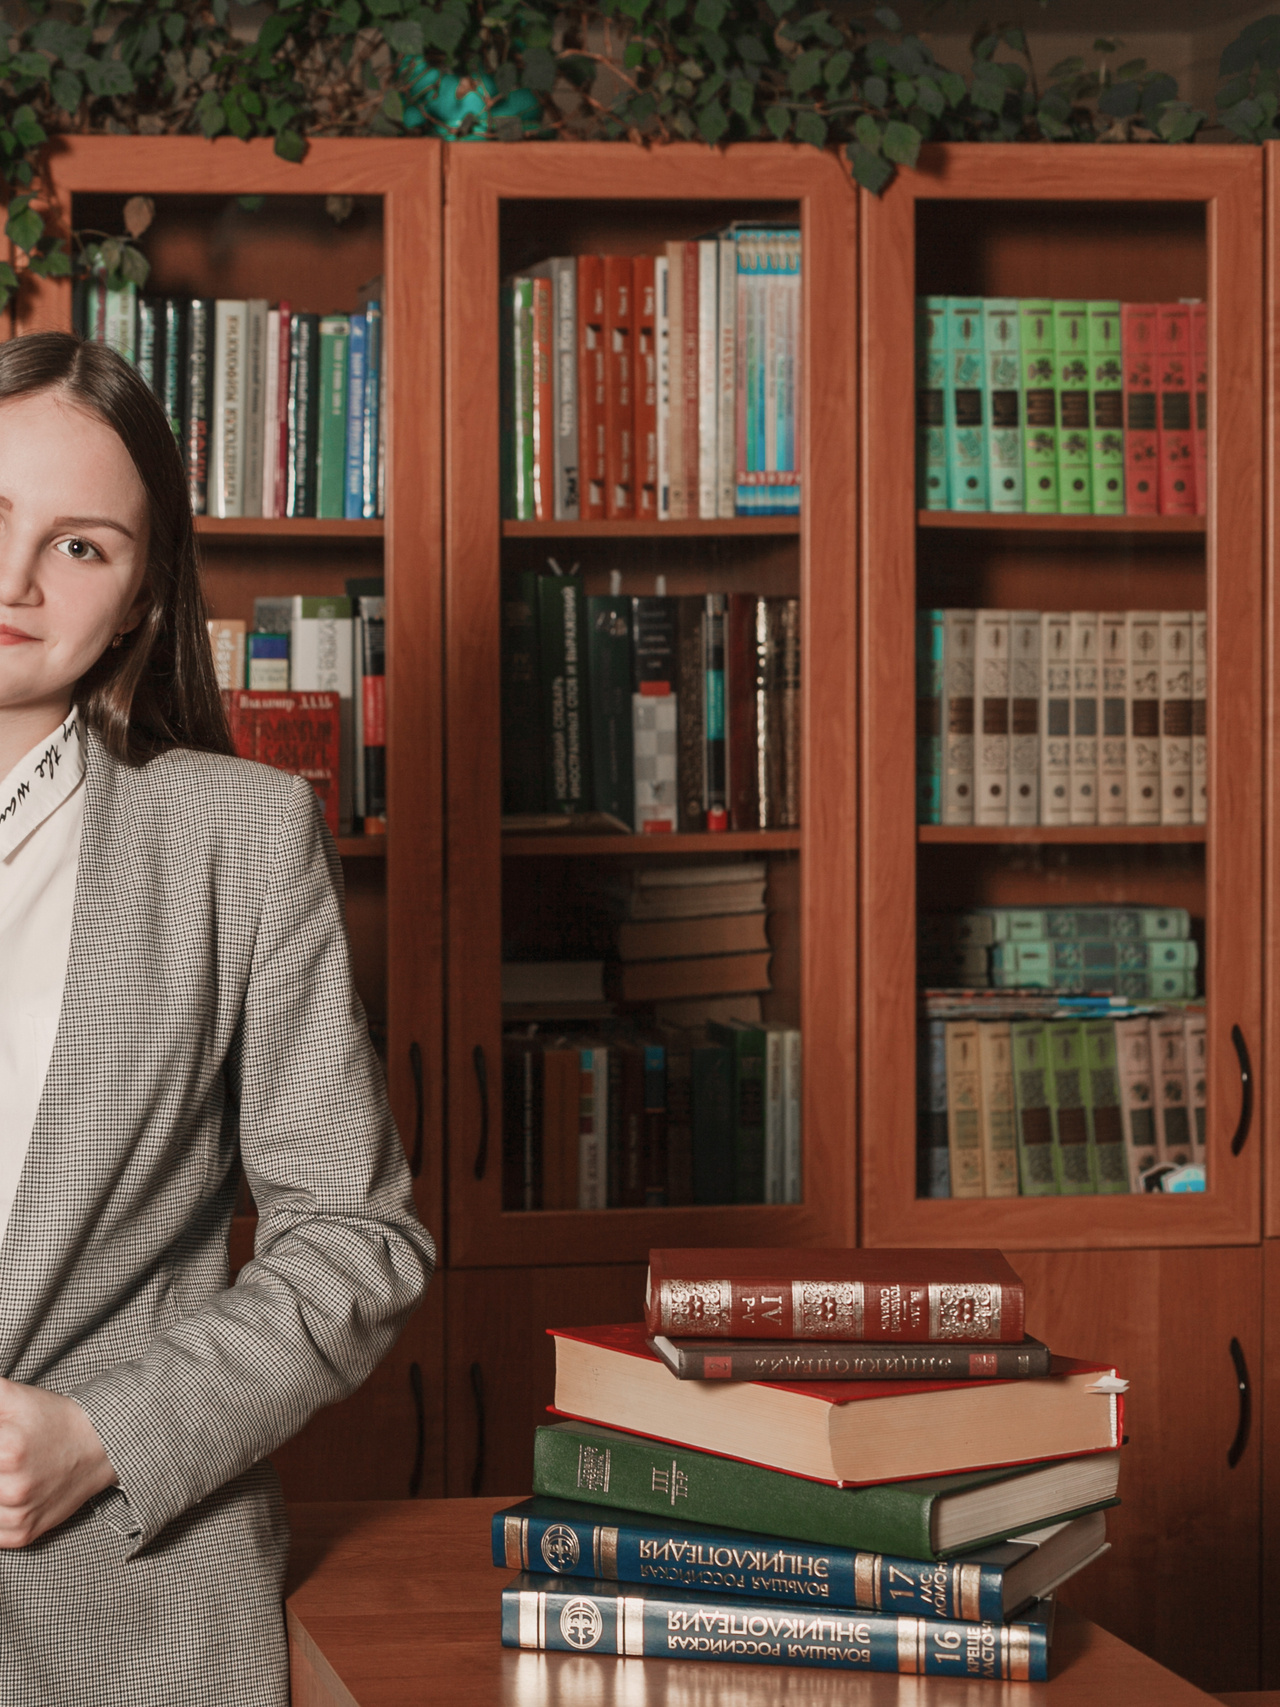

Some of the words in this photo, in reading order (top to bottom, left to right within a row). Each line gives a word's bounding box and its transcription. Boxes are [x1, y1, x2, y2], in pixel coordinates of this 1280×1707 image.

[34, 744, 62, 780] the
[761, 1295, 783, 1326] IV
[753, 1355, 952, 1377] ЭНЦИКЛОПЕДИЯ
[651, 1466, 670, 1494] III
[674, 1469, 689, 1498] П-Р
[638, 1538, 830, 1579] ЭНЦИКЛОПЕДИЯ
[639, 1563, 746, 1588] РОССИЙСКАЯ
[751, 1576, 830, 1597] БОЛЬШАЯ
[888, 1564, 915, 1600] 17
[919, 1572, 934, 1604] ЛАС
[667, 1609, 872, 1643] ЭНЦИКЛОПЕДИЯ
[667, 1635, 781, 1657] РОССИЙСКАЯ
[788, 1643, 871, 1663] БОЛЬШАЯ
[933, 1629, 962, 1664] 16
